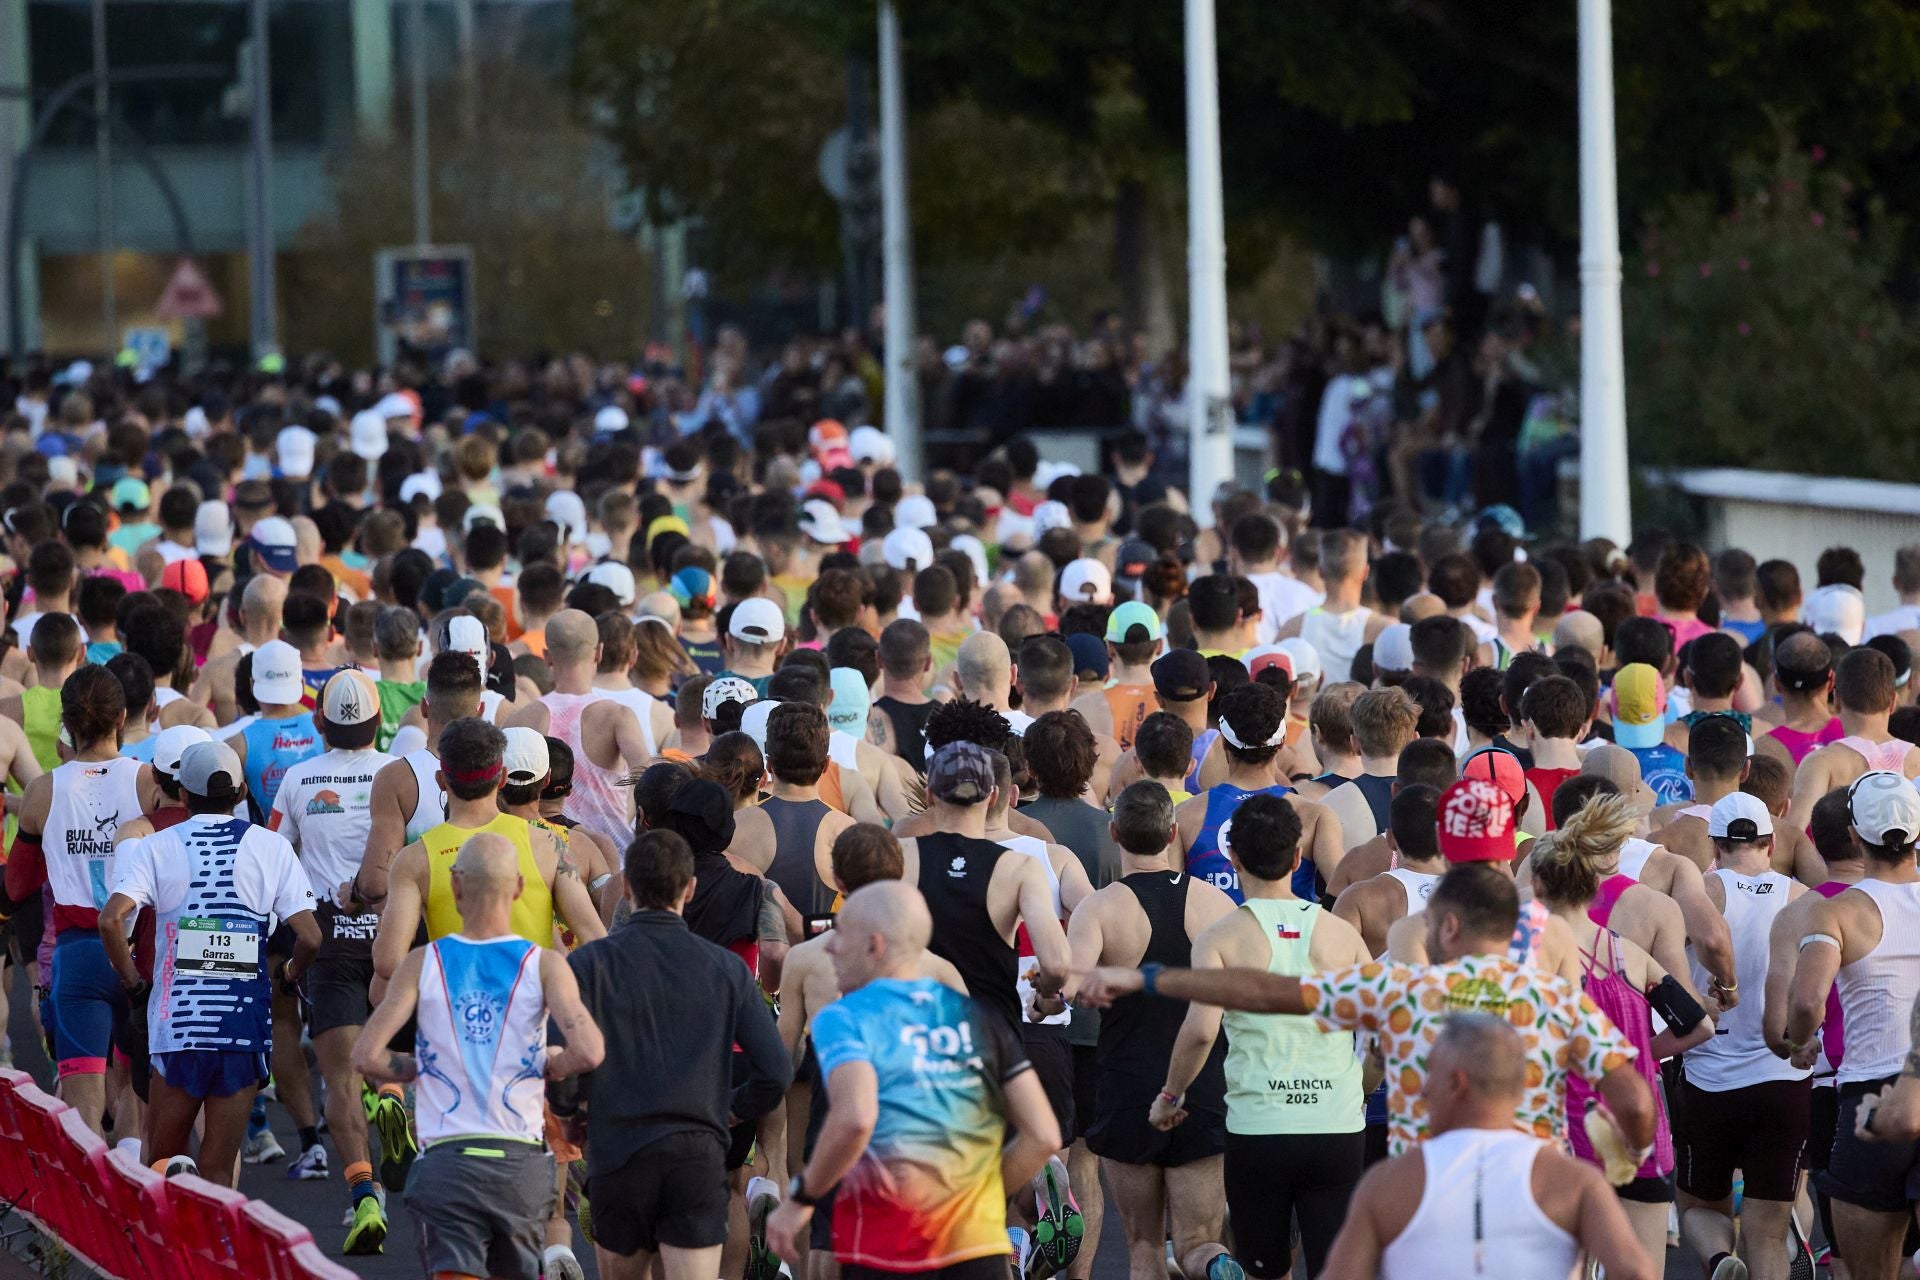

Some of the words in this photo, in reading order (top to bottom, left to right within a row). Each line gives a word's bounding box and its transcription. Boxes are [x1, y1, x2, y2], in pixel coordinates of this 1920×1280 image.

[301, 775, 332, 786] ATLÉTICO
[333, 775, 357, 784] CLUBE
[358, 773, 373, 782] SÃO
[66, 829, 94, 842] BULL
[208, 934, 231, 947] 113
[202, 949, 235, 960] Garras
[1268, 1079, 1333, 1091] VALENCIA
[1285, 1093, 1318, 1105] 2025
